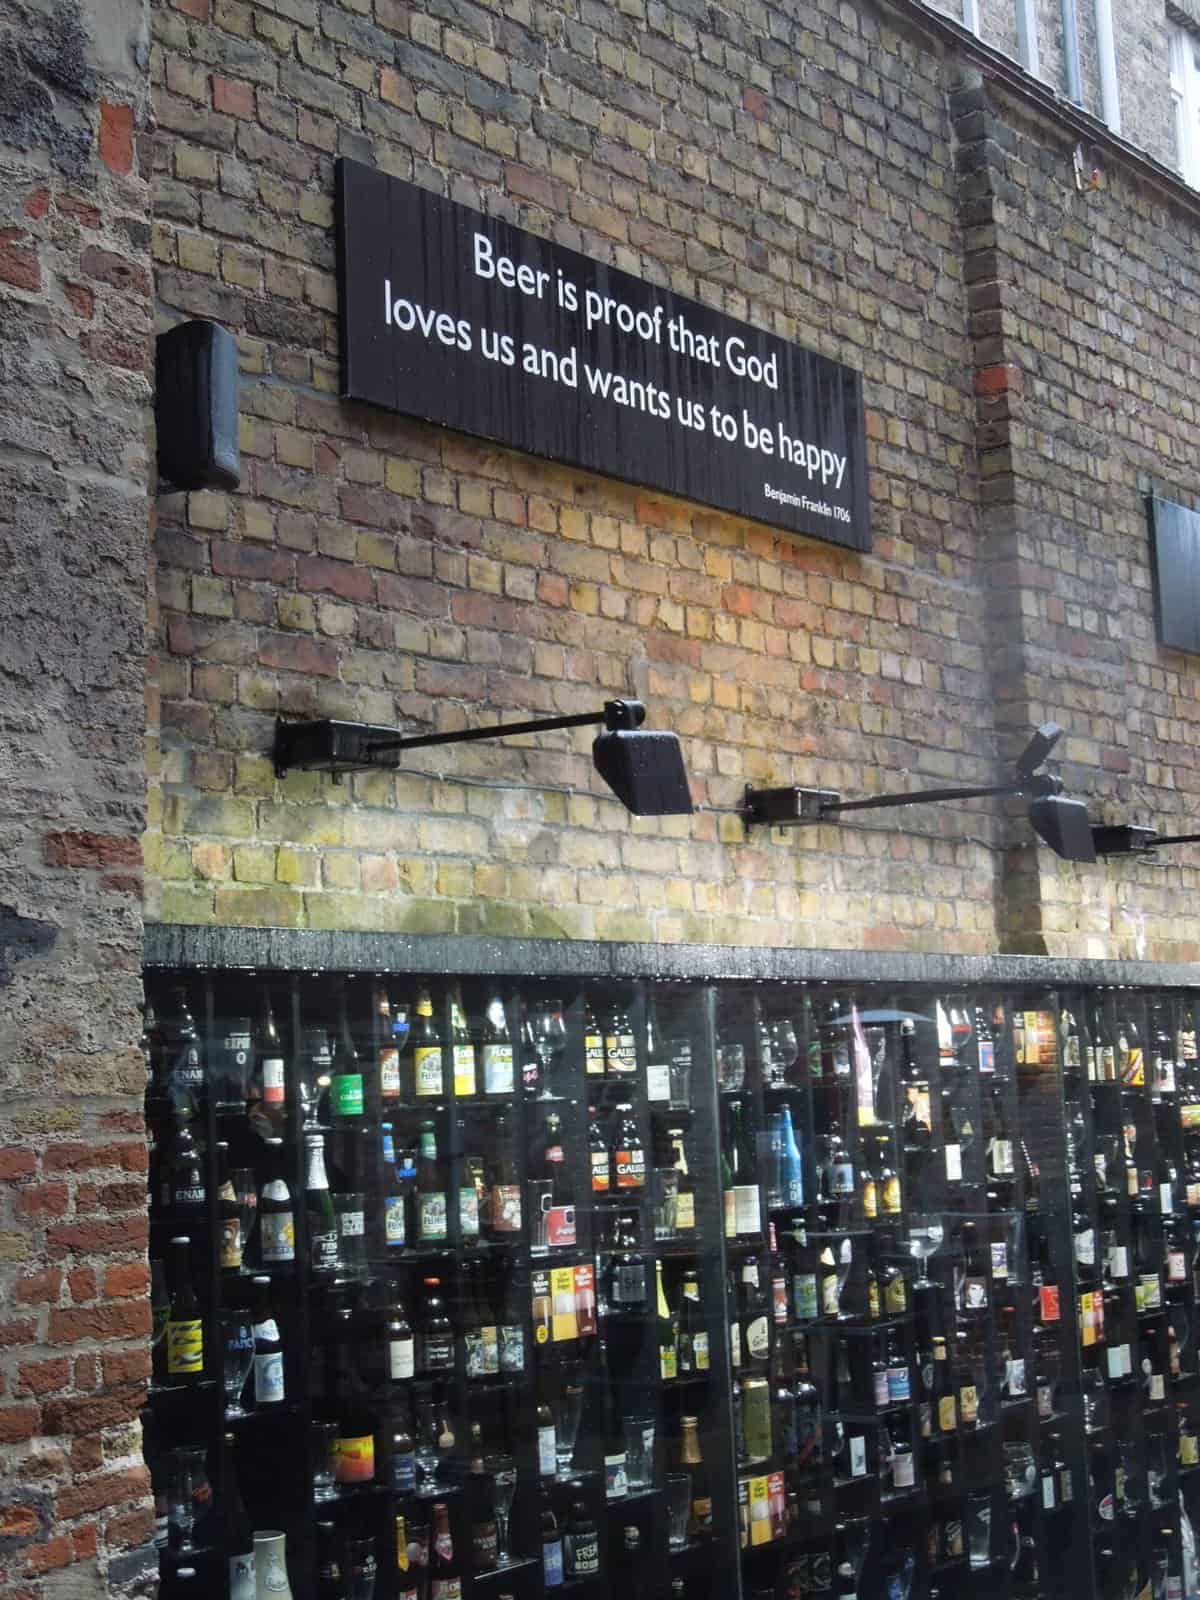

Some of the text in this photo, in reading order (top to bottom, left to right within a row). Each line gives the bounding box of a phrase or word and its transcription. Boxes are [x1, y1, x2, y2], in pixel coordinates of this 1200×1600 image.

[384, 279, 847, 489] loves us and wants us to be happy
[473, 231, 779, 390] Beer is proof that God
[764, 482, 851, 523] Benjamin Franklin 1706
